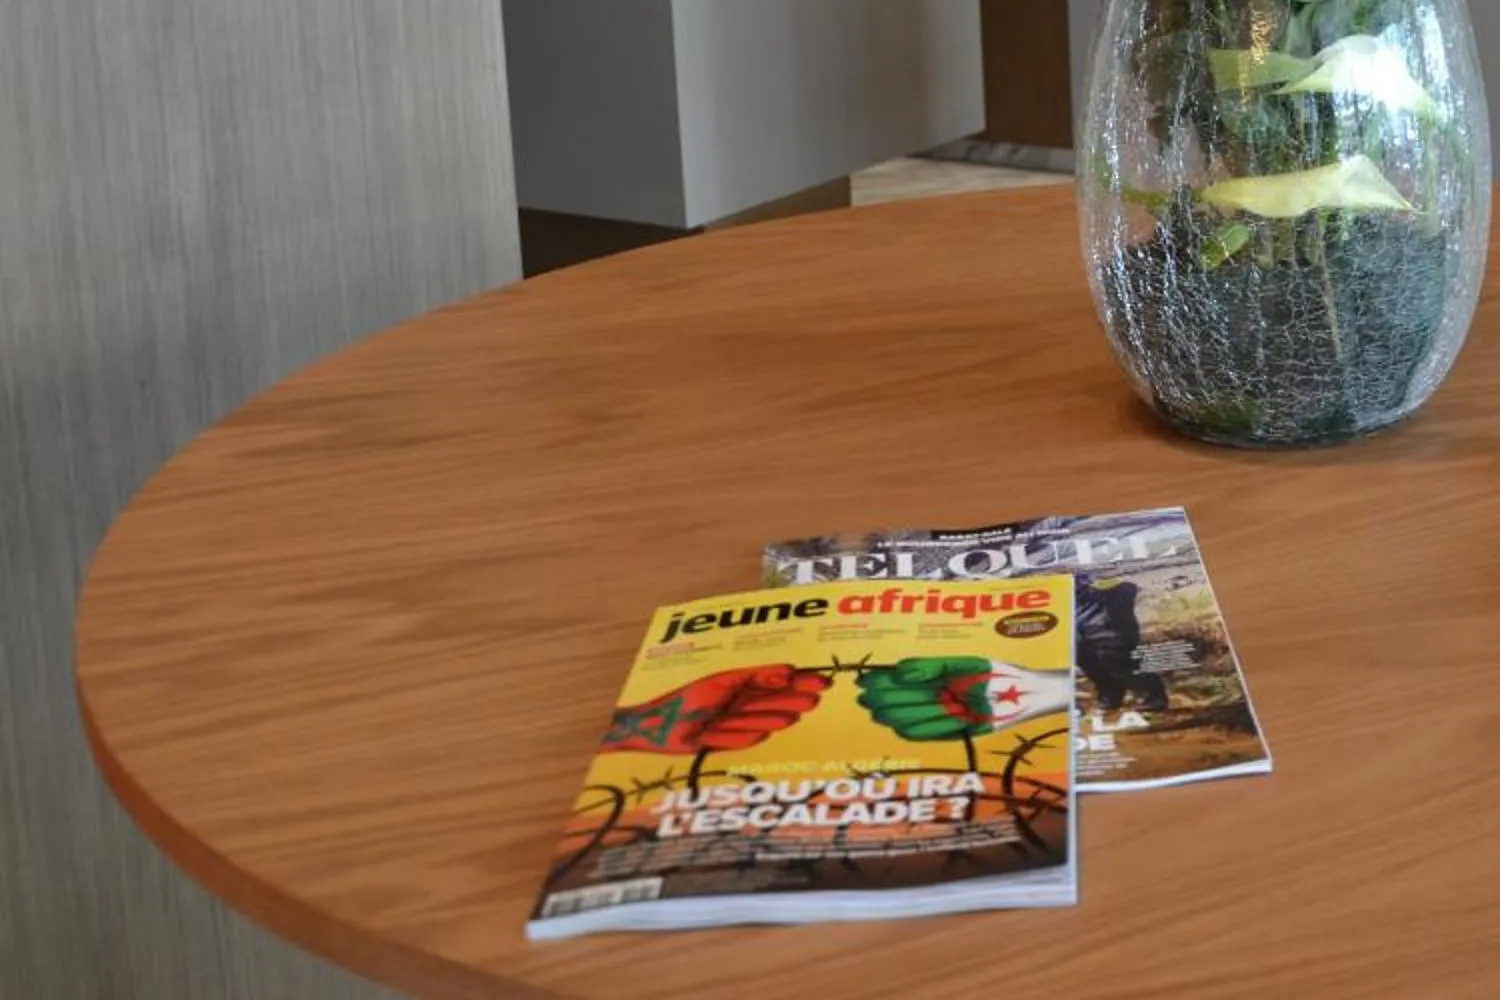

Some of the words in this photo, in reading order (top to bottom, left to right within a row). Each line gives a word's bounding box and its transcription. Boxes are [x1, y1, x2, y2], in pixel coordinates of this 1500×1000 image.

[660, 597, 829, 643] jeune
[836, 588, 1051, 618] afrique
[908, 771, 985, 798] IRA
[655, 797, 935, 838] L'ESCALADE
